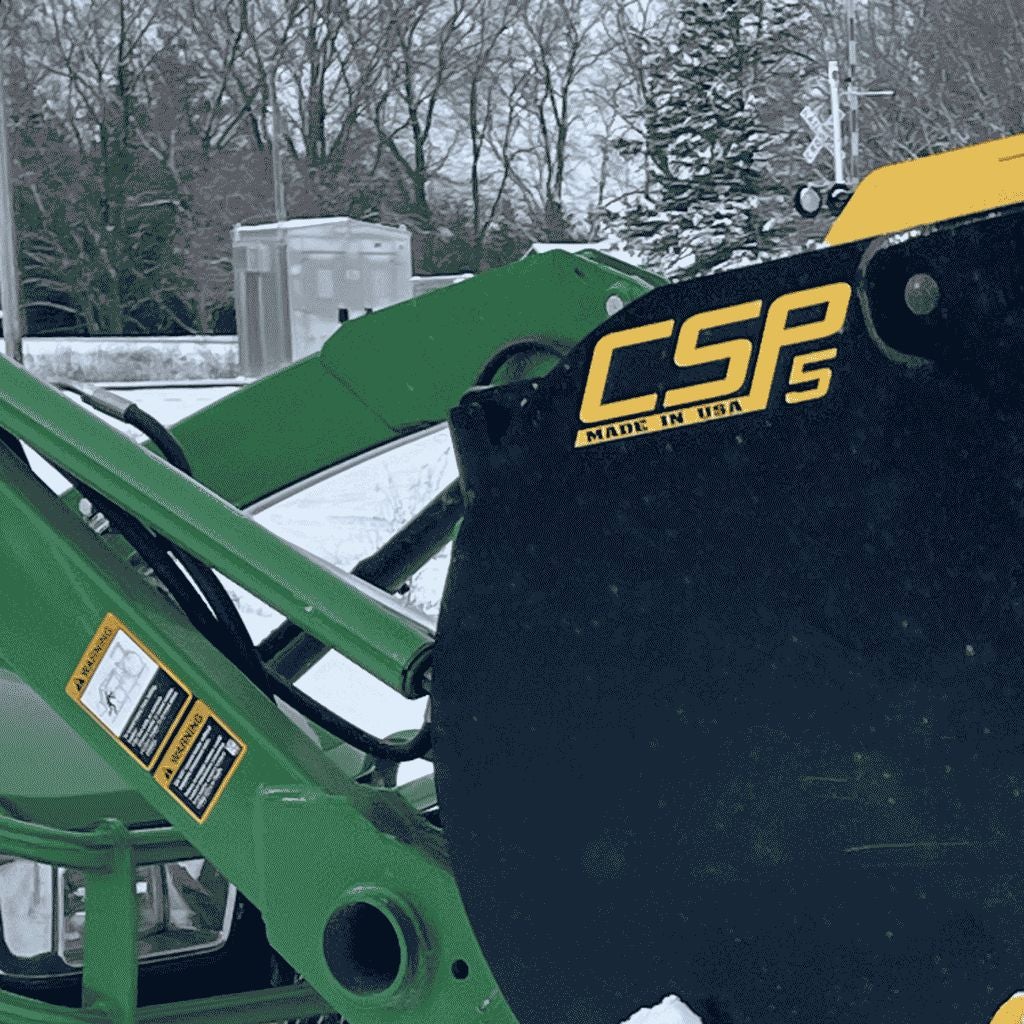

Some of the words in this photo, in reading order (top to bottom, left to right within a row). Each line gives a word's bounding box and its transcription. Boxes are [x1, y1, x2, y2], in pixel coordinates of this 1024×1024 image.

[579, 282, 851, 423] CSP
[785, 348, 838, 404] 5
[586, 419, 648, 443] MADE
[661, 412, 684, 427] IN
[697, 400, 742, 420] USA
[170, 713, 203, 763] WARNING
